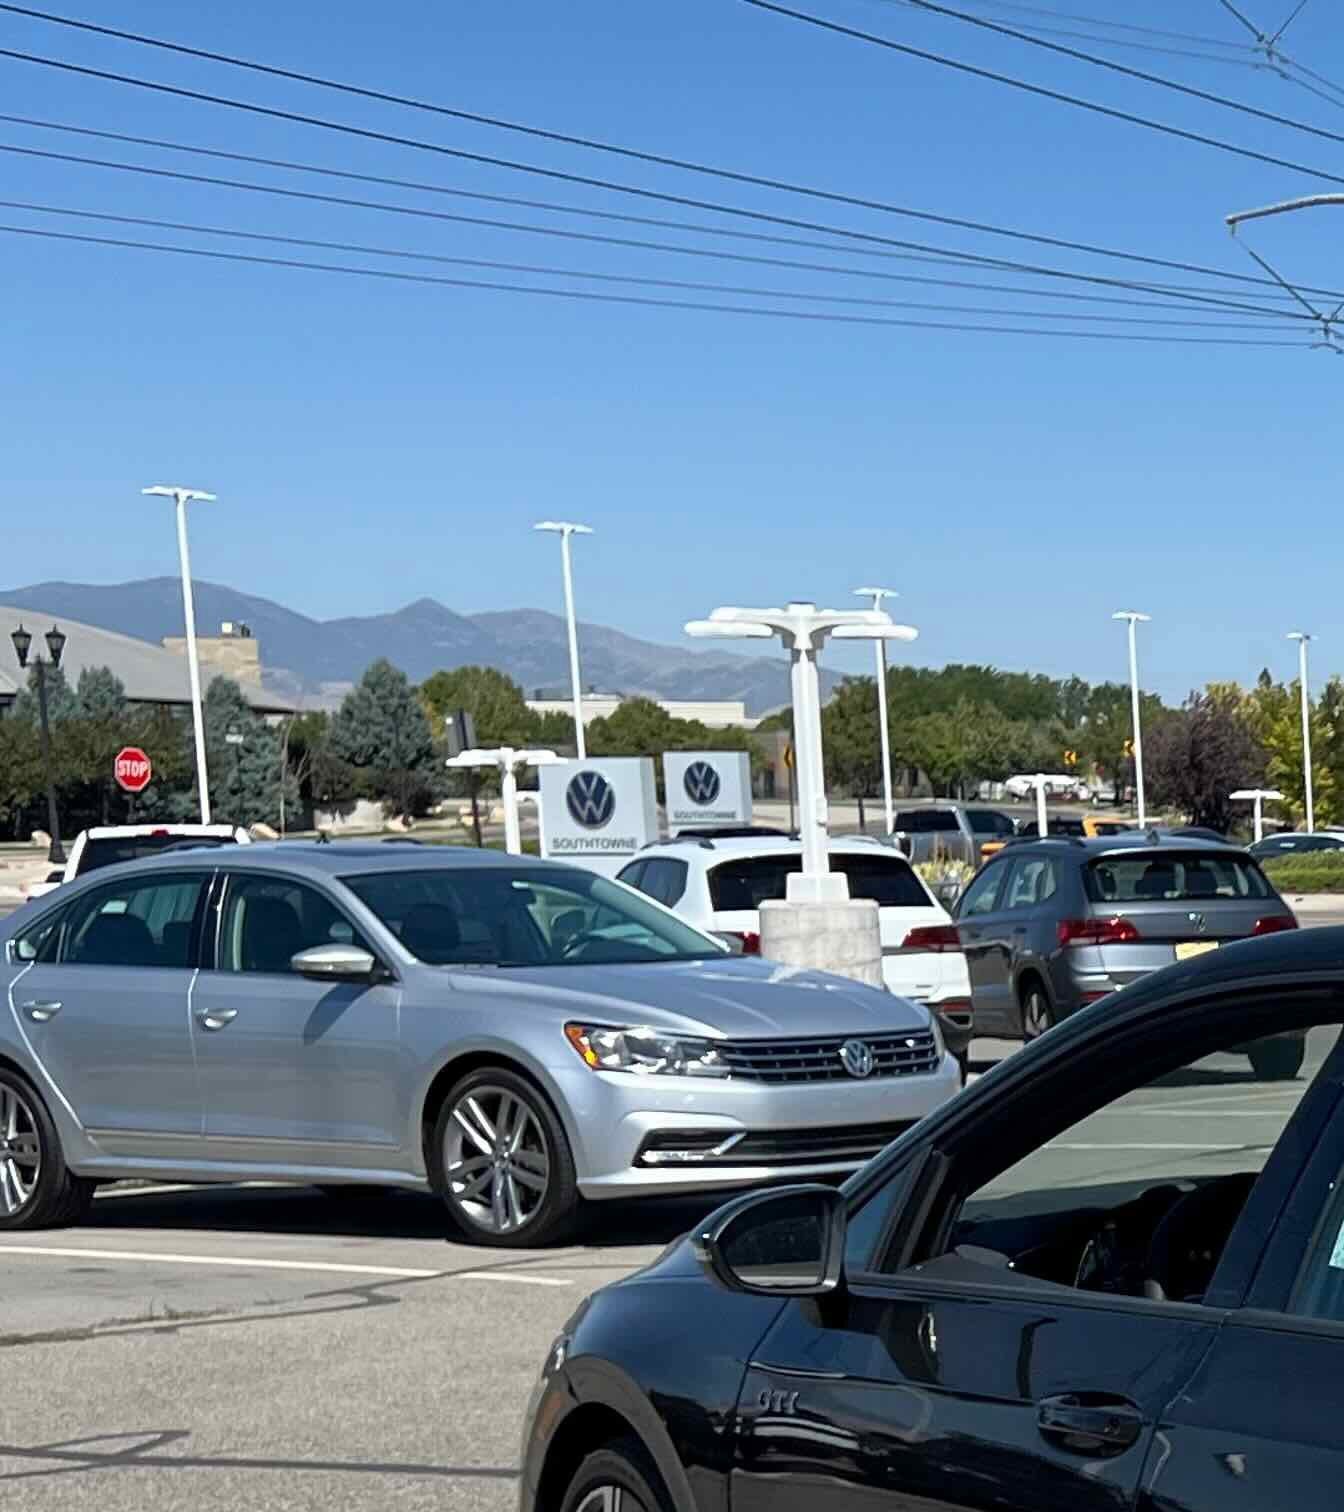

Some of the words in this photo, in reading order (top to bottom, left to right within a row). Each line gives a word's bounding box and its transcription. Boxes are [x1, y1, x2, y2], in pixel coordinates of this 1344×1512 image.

[118, 759, 148, 777] STOP
[673, 809, 737, 820] SOUTHTOWNE
[552, 836, 638, 849] SOUTHTOWNE
[757, 1389, 799, 1415] GTI
